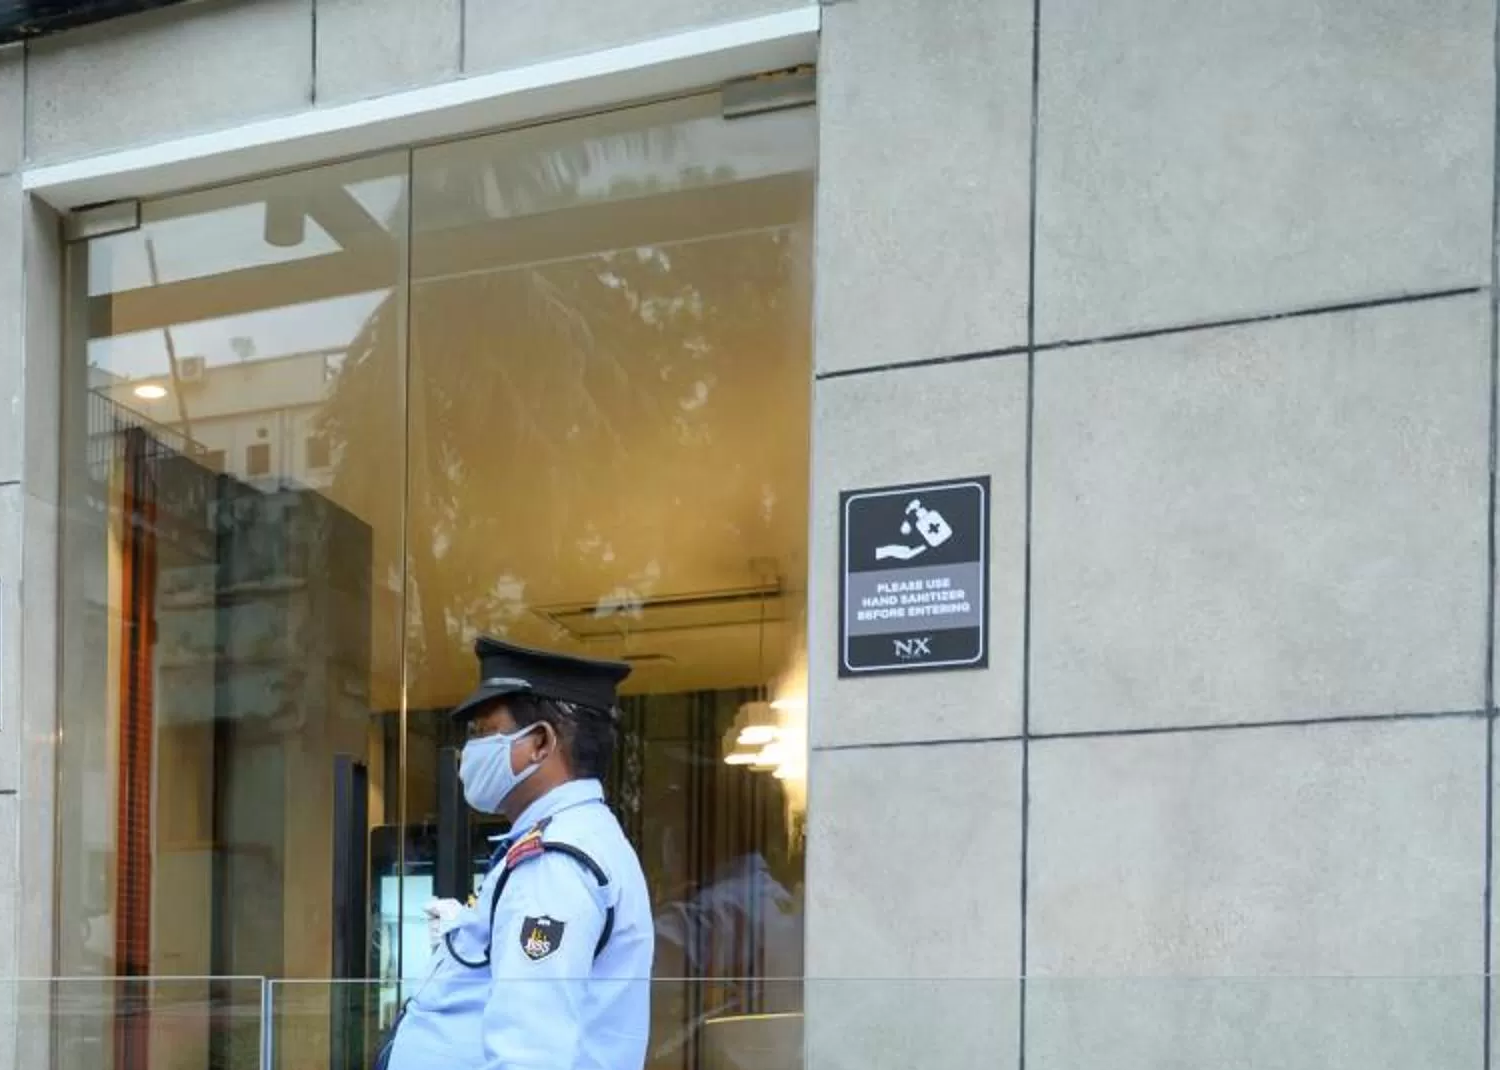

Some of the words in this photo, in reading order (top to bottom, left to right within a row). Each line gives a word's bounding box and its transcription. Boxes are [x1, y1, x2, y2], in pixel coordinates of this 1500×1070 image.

[876, 579, 923, 593] PLEASE
[925, 577, 950, 589] USE
[862, 594, 898, 608] HAND
[901, 589, 965, 604] SANITIZER
[857, 605, 905, 621] BEFORE
[907, 602, 971, 617] ENTERING
[893, 637, 931, 656] NX
